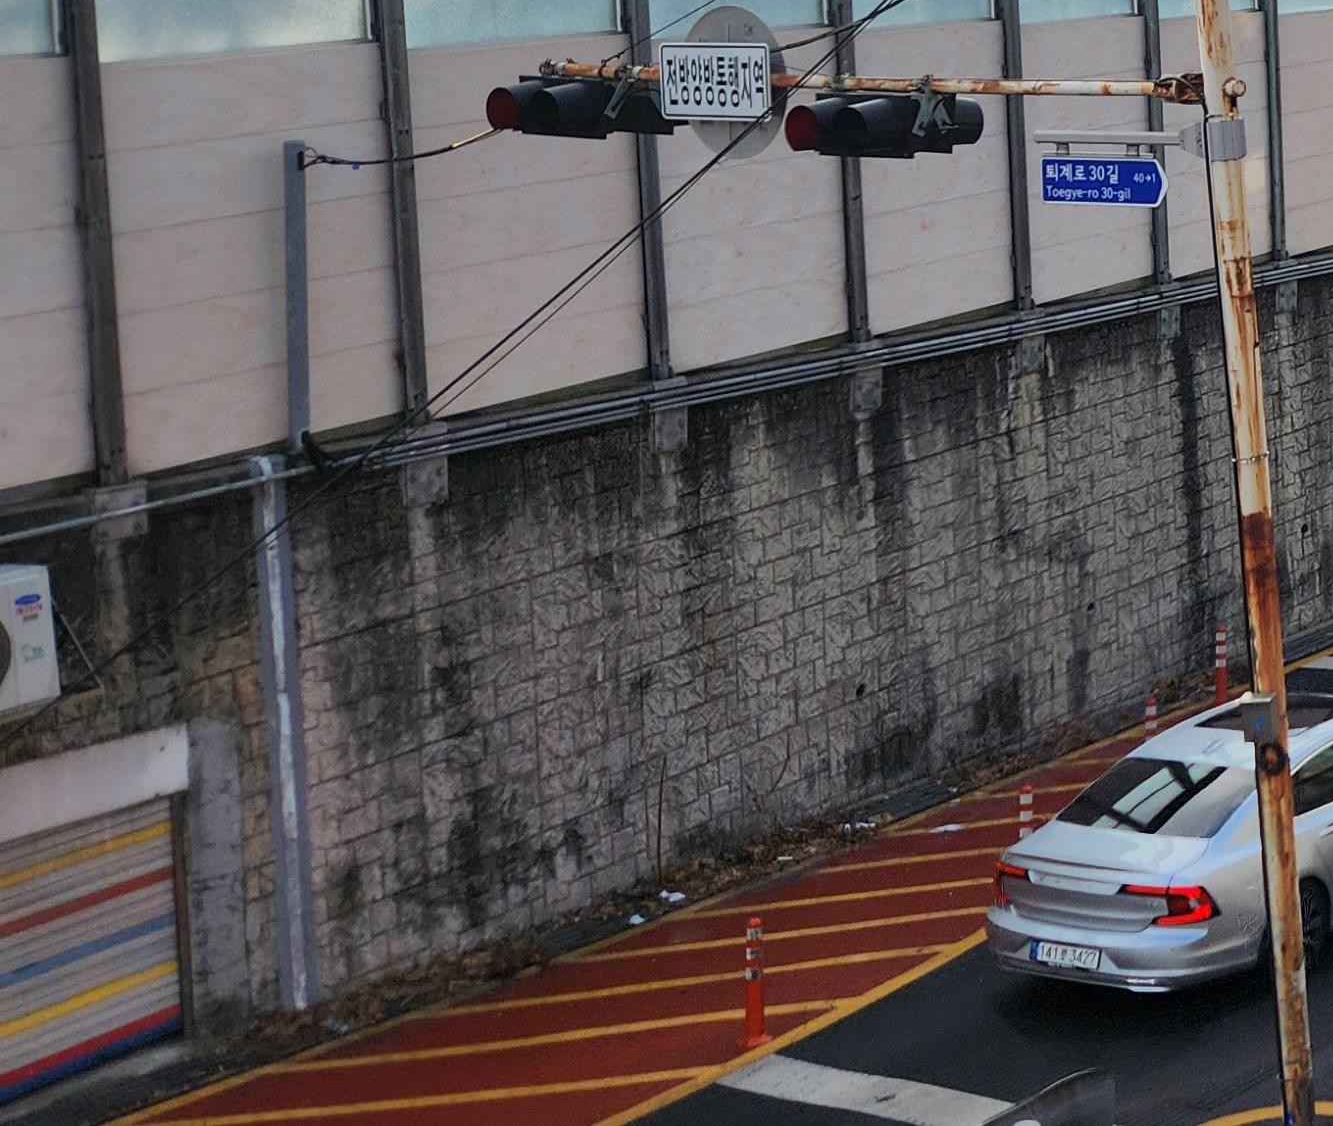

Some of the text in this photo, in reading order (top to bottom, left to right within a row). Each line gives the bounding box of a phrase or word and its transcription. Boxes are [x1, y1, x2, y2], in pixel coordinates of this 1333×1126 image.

[667, 55, 765, 108] 전방양방통행지역
[1046, 185, 1131, 202] Toegye-ro 30-gil
